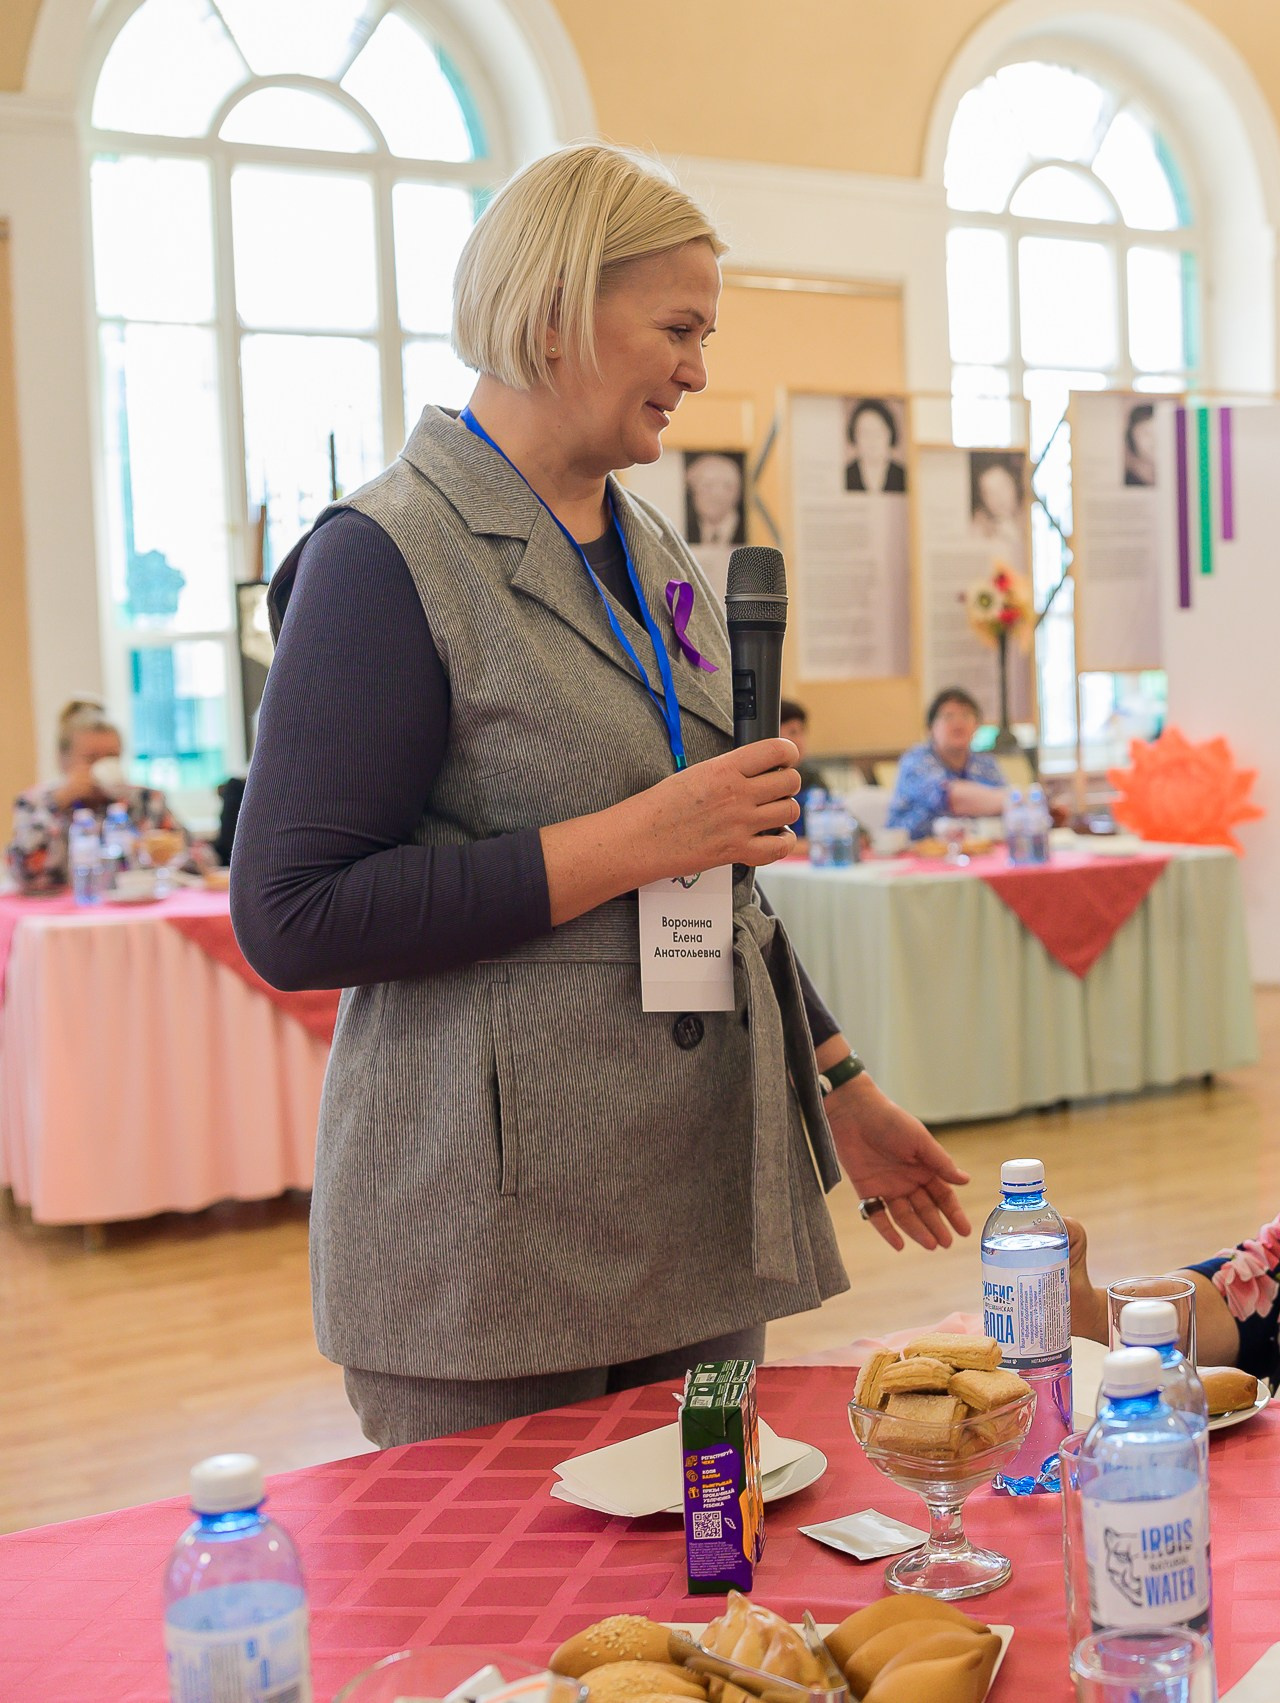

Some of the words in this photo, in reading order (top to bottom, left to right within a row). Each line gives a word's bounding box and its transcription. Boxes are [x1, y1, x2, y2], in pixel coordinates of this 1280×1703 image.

[661, 916, 713, 930] Воронина
[672, 932, 703, 943] Елена
[654, 946, 721, 958] Анатольевна
[1141, 1518, 1193, 1559] IRBIS
[1145, 1564, 1196, 1607] WATER
